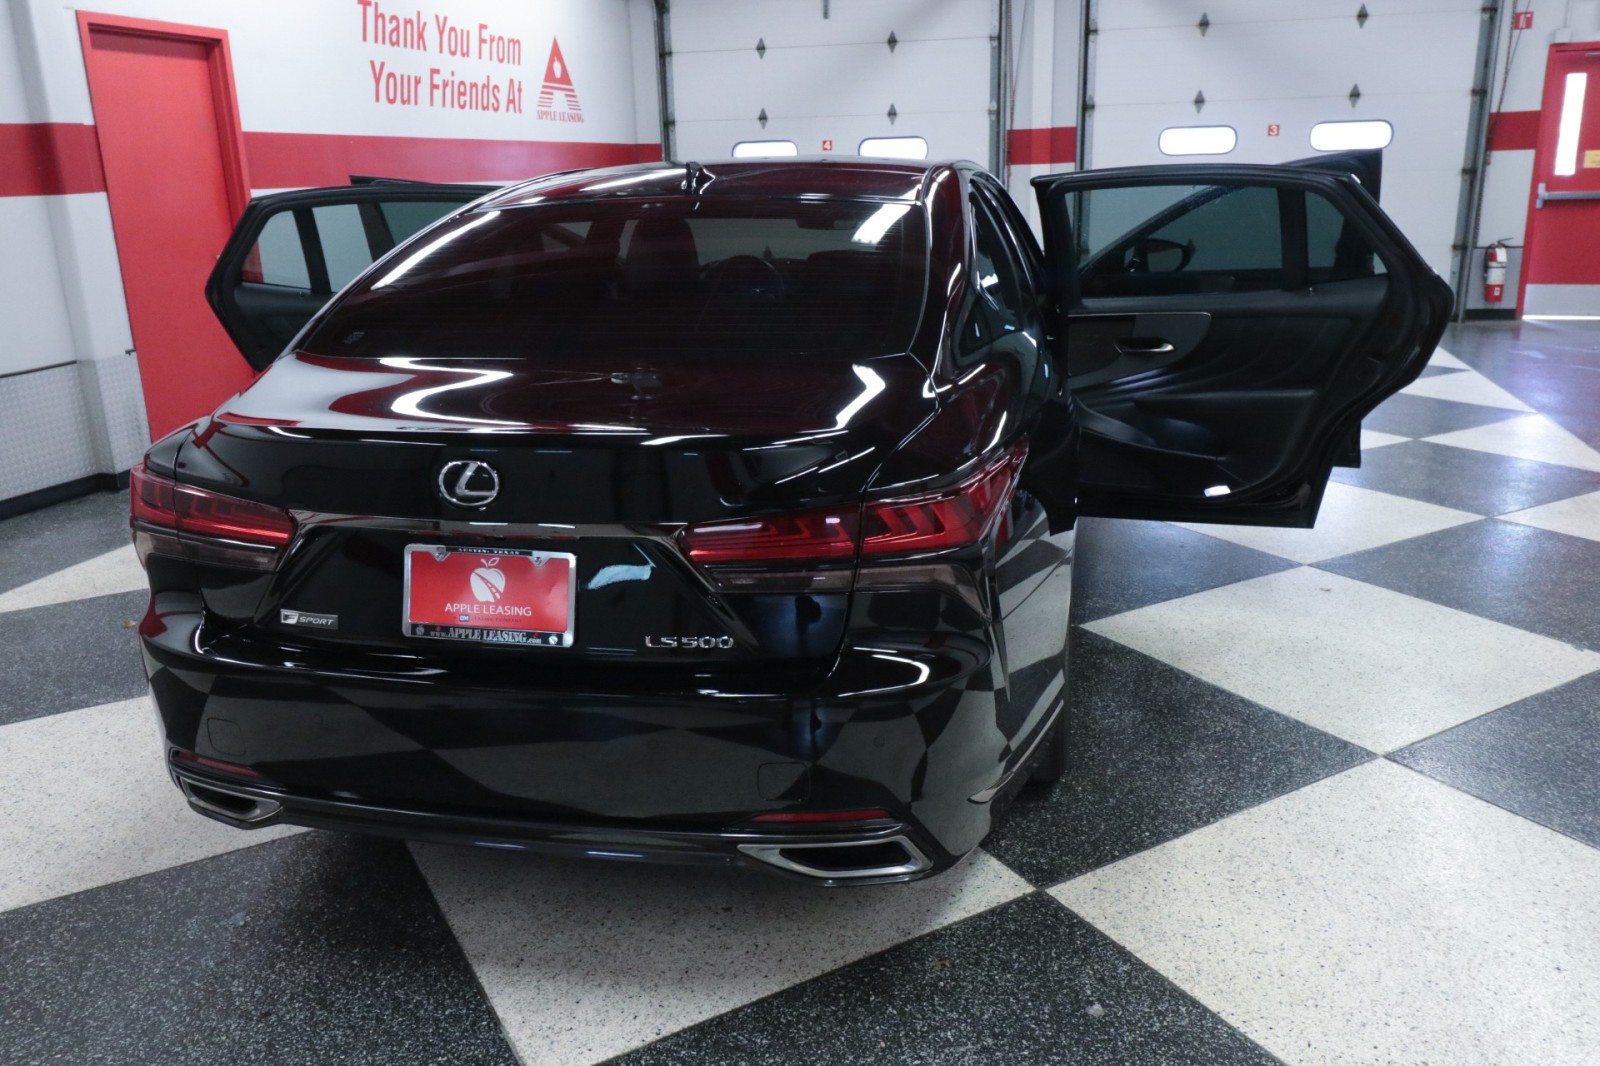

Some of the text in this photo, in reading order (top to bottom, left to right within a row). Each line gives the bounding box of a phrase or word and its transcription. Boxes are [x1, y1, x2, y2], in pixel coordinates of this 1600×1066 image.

[357, 0, 522, 66] Thank You From
[369, 60, 523, 114] Your Friends At
[536, 110, 585, 123] APPLE LEASING
[1269, 125, 1278, 136] 3
[823, 140, 831, 150] 4
[445, 603, 532, 616] APPLE LEASING
[299, 616, 335, 626] SPORT
